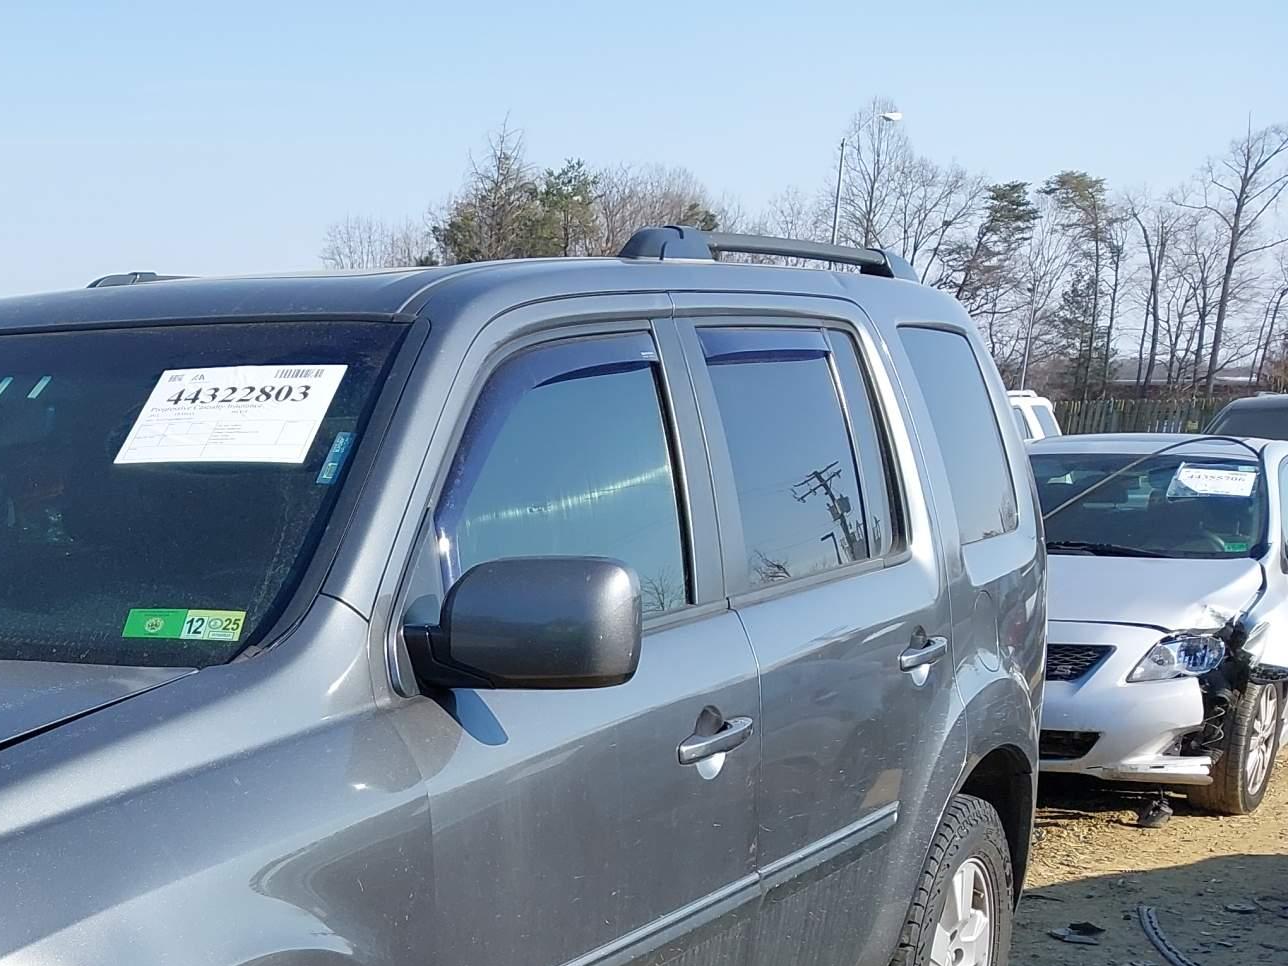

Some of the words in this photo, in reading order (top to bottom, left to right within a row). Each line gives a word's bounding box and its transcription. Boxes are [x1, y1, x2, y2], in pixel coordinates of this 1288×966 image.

[166, 385, 311, 405] 44322803
[185, 617, 204, 635] 12
[222, 618, 241, 631] 25
